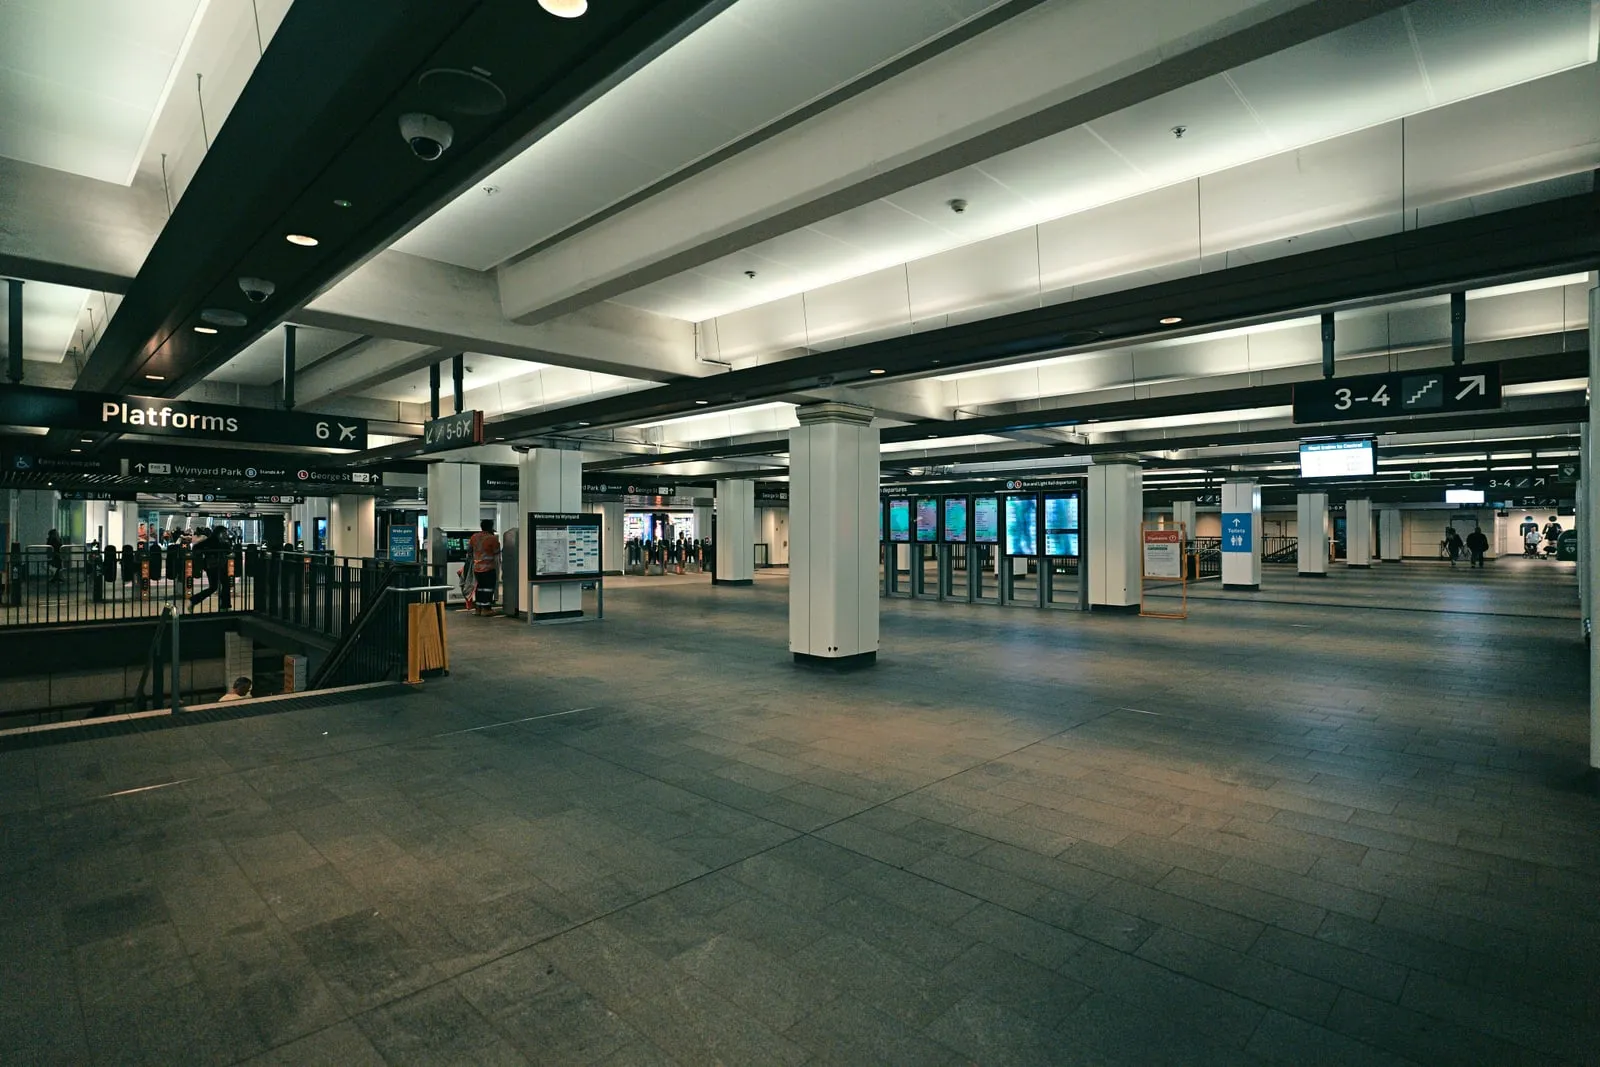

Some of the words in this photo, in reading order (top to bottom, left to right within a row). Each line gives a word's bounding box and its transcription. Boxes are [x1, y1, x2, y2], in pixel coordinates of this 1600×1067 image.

[1333, 384, 1391, 410] 3-4
[102, 402, 239, 432] Platforms
[315, 421, 330, 439] 6
[446, 422, 461, 440] 5-6
[162, 465, 168, 473] 1
[174, 465, 219, 476] Wynyard
[221, 467, 242, 476] Park
[310, 472, 340, 482] George
[1489, 479, 1511, 488] 3-4
[97, 491, 111, 499] Lift
